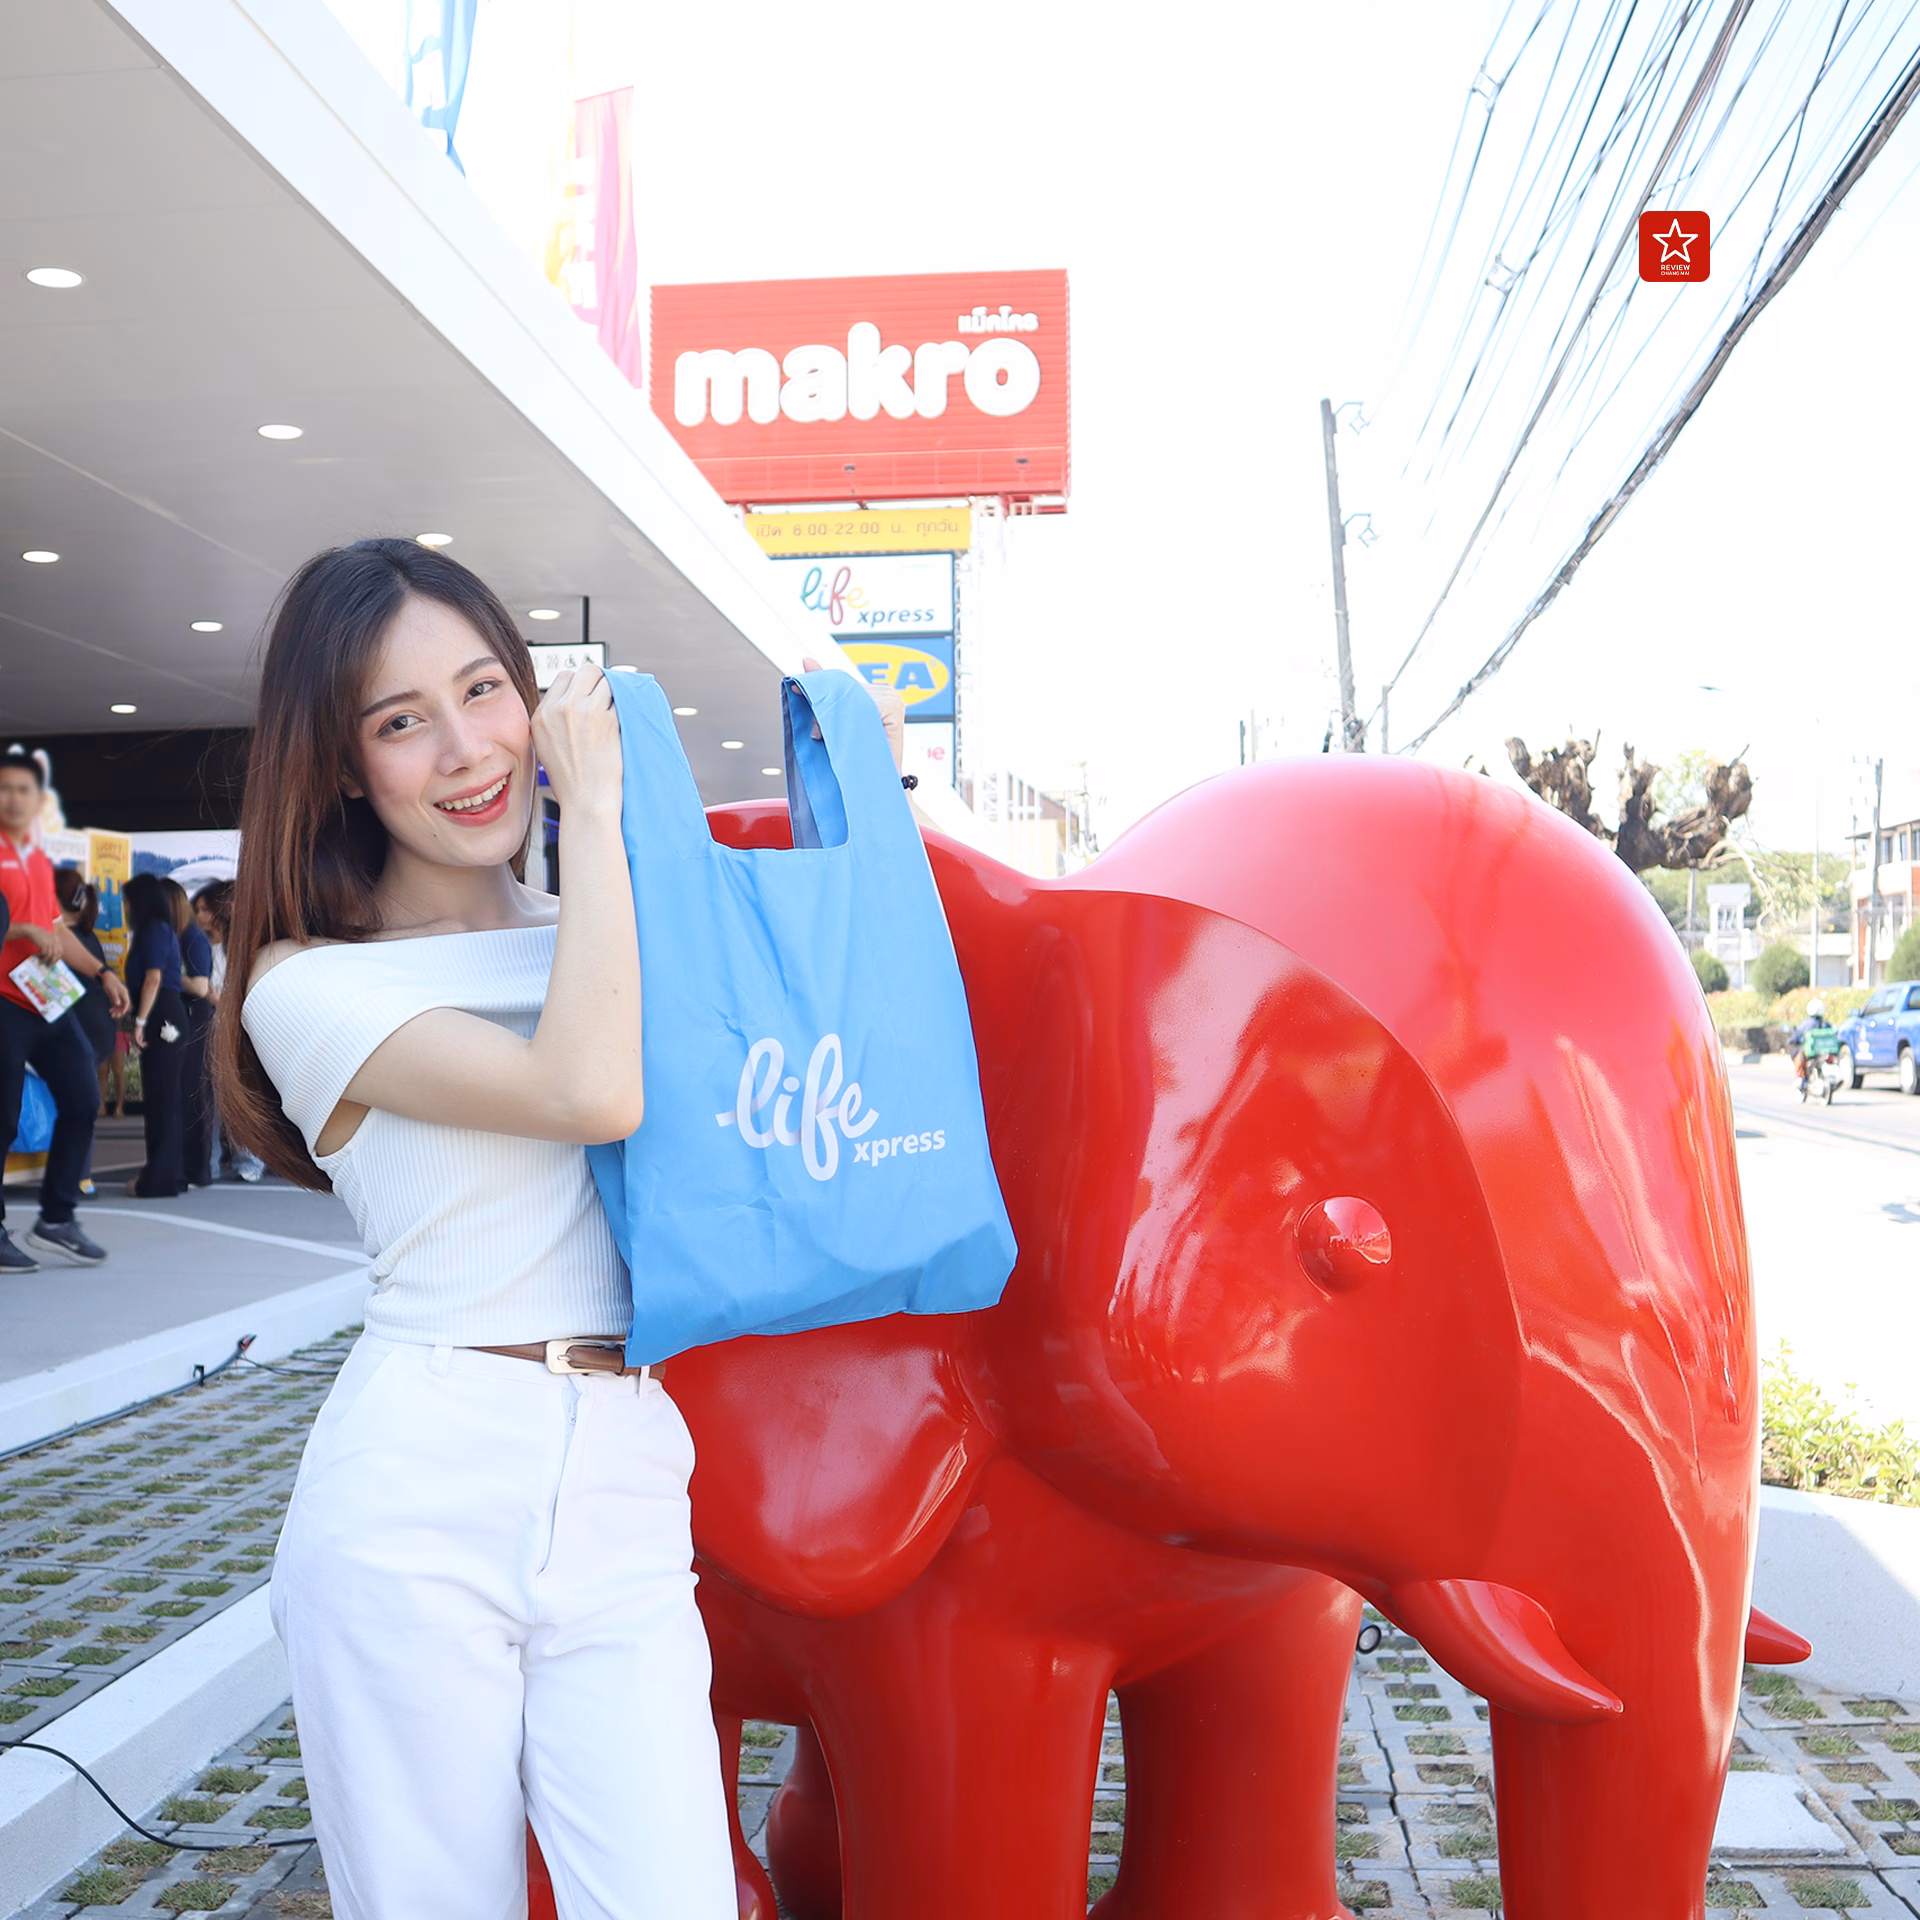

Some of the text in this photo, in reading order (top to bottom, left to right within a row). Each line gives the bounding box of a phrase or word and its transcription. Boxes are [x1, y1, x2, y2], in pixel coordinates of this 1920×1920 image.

[674, 321, 1041, 427] makro
[756, 523, 782, 538] เปิด
[793, 521, 880, 537] 6.00-22.00
[916, 518, 959, 540] ทุกวัน
[800, 566, 870, 626] life
[857, 607, 935, 628] xpress
[856, 661, 936, 690] EA
[715, 1033, 880, 1182] life
[853, 1129, 946, 1167] xpress
